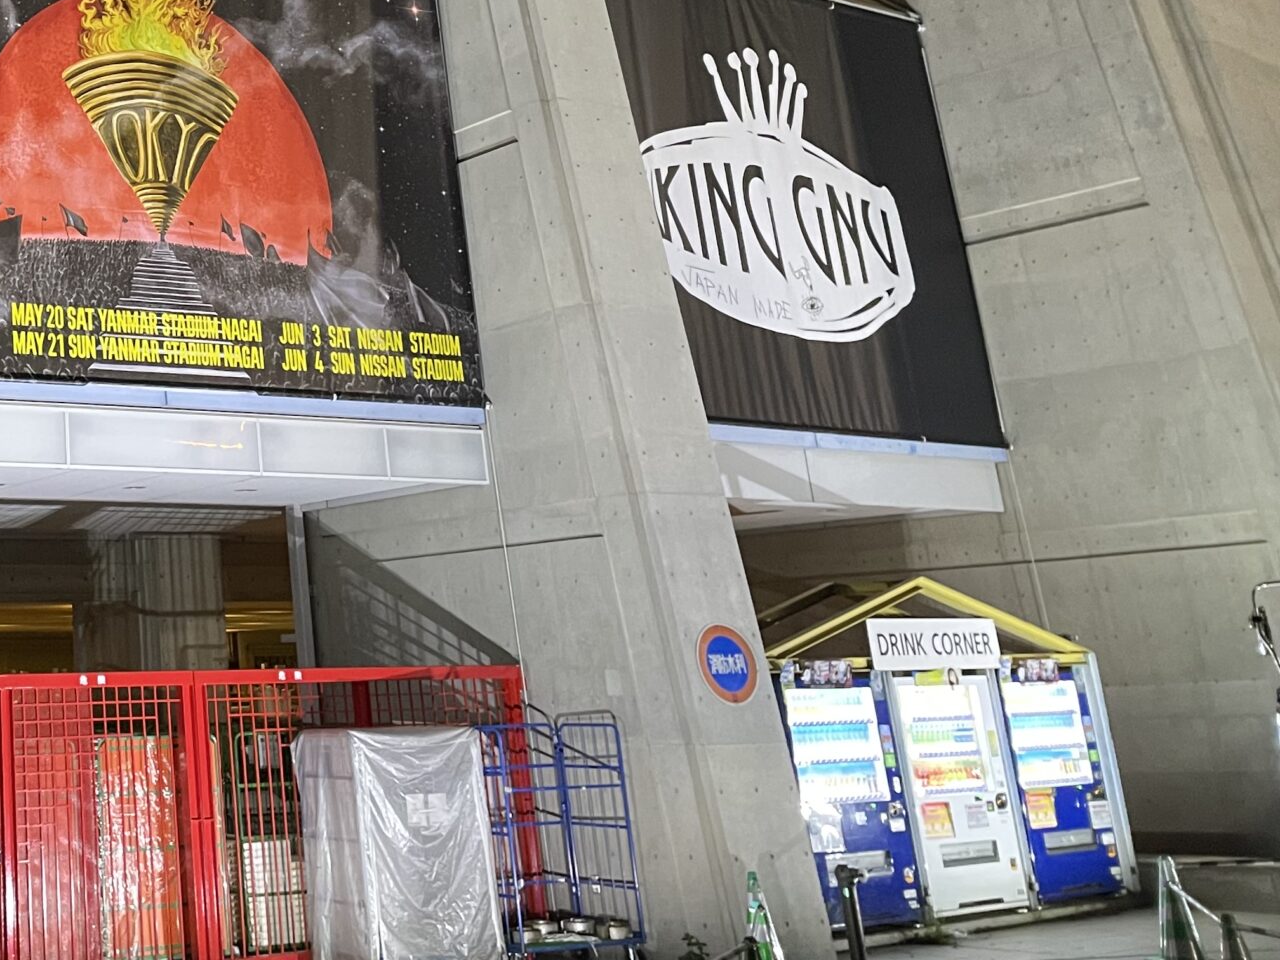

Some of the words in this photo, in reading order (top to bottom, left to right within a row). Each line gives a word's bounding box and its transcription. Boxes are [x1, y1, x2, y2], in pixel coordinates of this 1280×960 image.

[653, 162, 788, 284] KING
[791, 174, 900, 286] GNU
[680, 263, 740, 306] JAPAN
[11, 302, 44, 327] MAY
[46, 304, 65, 329] 20
[67, 306, 95, 331] SAT
[97, 308, 159, 336] YANMAR
[162, 312, 219, 340] STADIUM
[221, 317, 263, 343] NAGAI
[279, 321, 305, 346] JUN
[311, 324, 322, 347] 3
[328, 325, 351, 349] SAT
[357, 327, 404, 353] NISSAN
[409, 331, 462, 357] STADIUM
[12, 330, 45, 356] MAY
[48, 332, 65, 358] 21
[68, 334, 97, 359] SUN
[99, 335, 161, 363] YANMAR
[163, 340, 222, 367] STADIUM
[223, 344, 265, 370] NAGAI
[282, 348, 308, 372] JUN
[314, 350, 325, 374] 4
[330, 351, 356, 376] SUN
[360, 353, 407, 379] NISSAN
[412, 356, 465, 383] STADIUM
[876, 632, 928, 657] DRINK
[931, 632, 994, 657] CORNER
